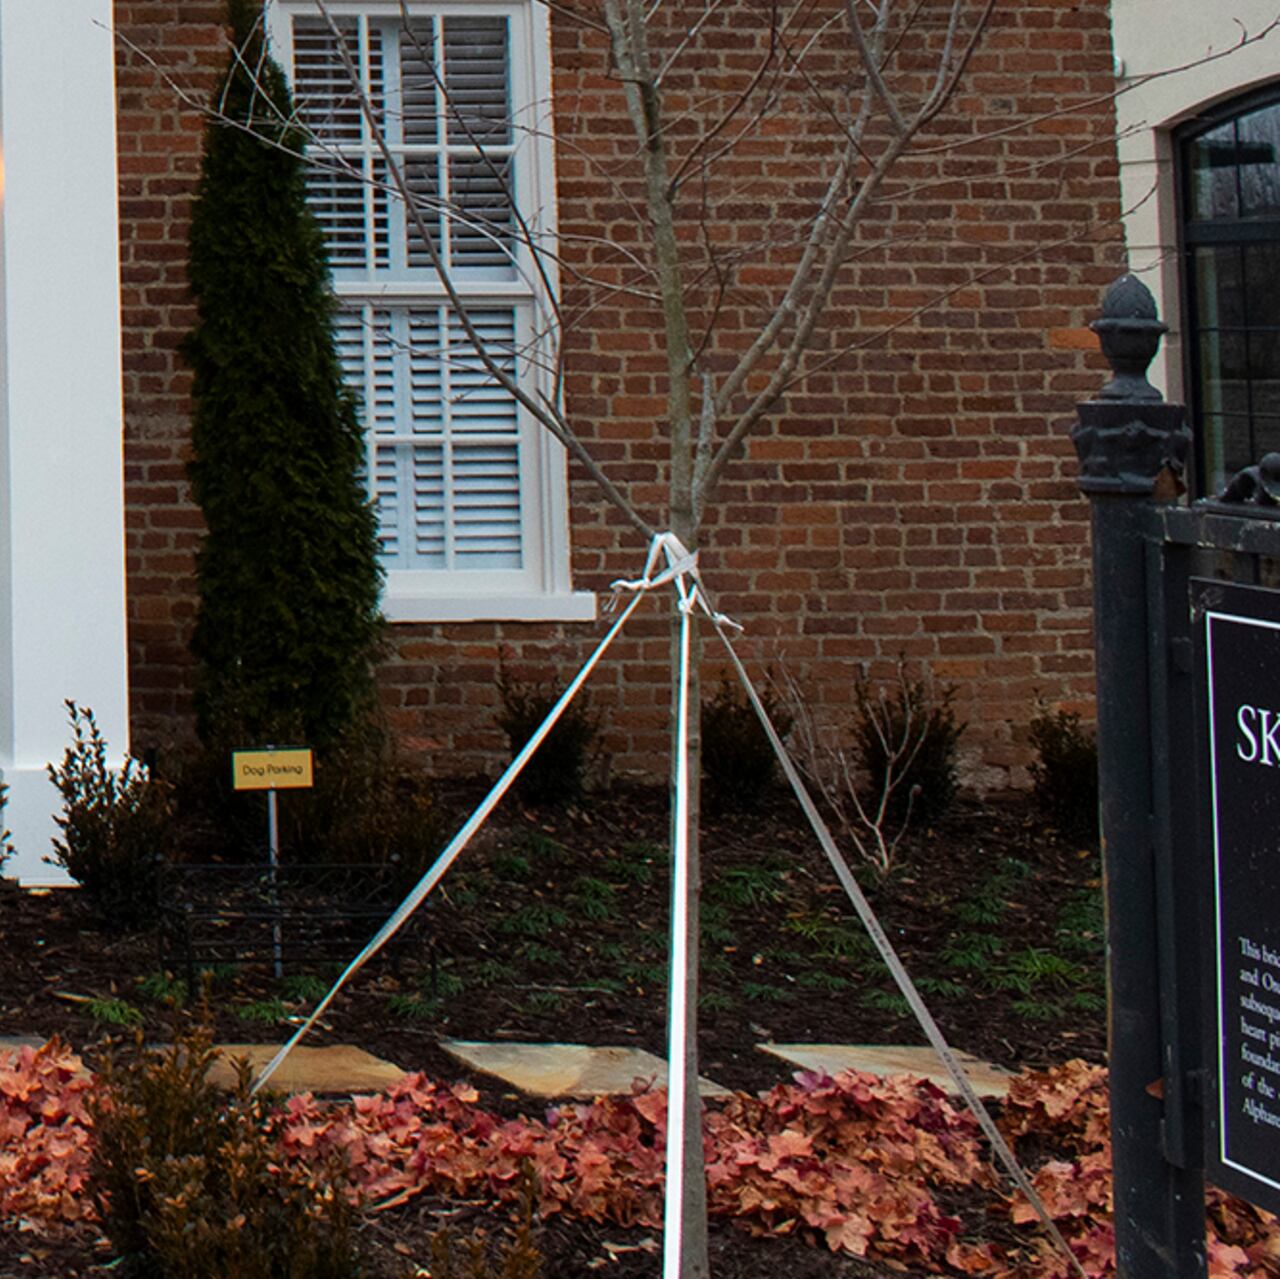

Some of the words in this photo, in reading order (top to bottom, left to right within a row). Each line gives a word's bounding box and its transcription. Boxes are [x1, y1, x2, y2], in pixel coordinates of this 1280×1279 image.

[242, 764, 265, 776] Dog
[267, 763, 303, 775] Parking
[1238, 936, 1261, 960] This
[1240, 968, 1259, 987] and
[1241, 1015, 1266, 1041] heart
[1241, 1071, 1255, 1089] of
[1257, 1076, 1276, 1099] the
